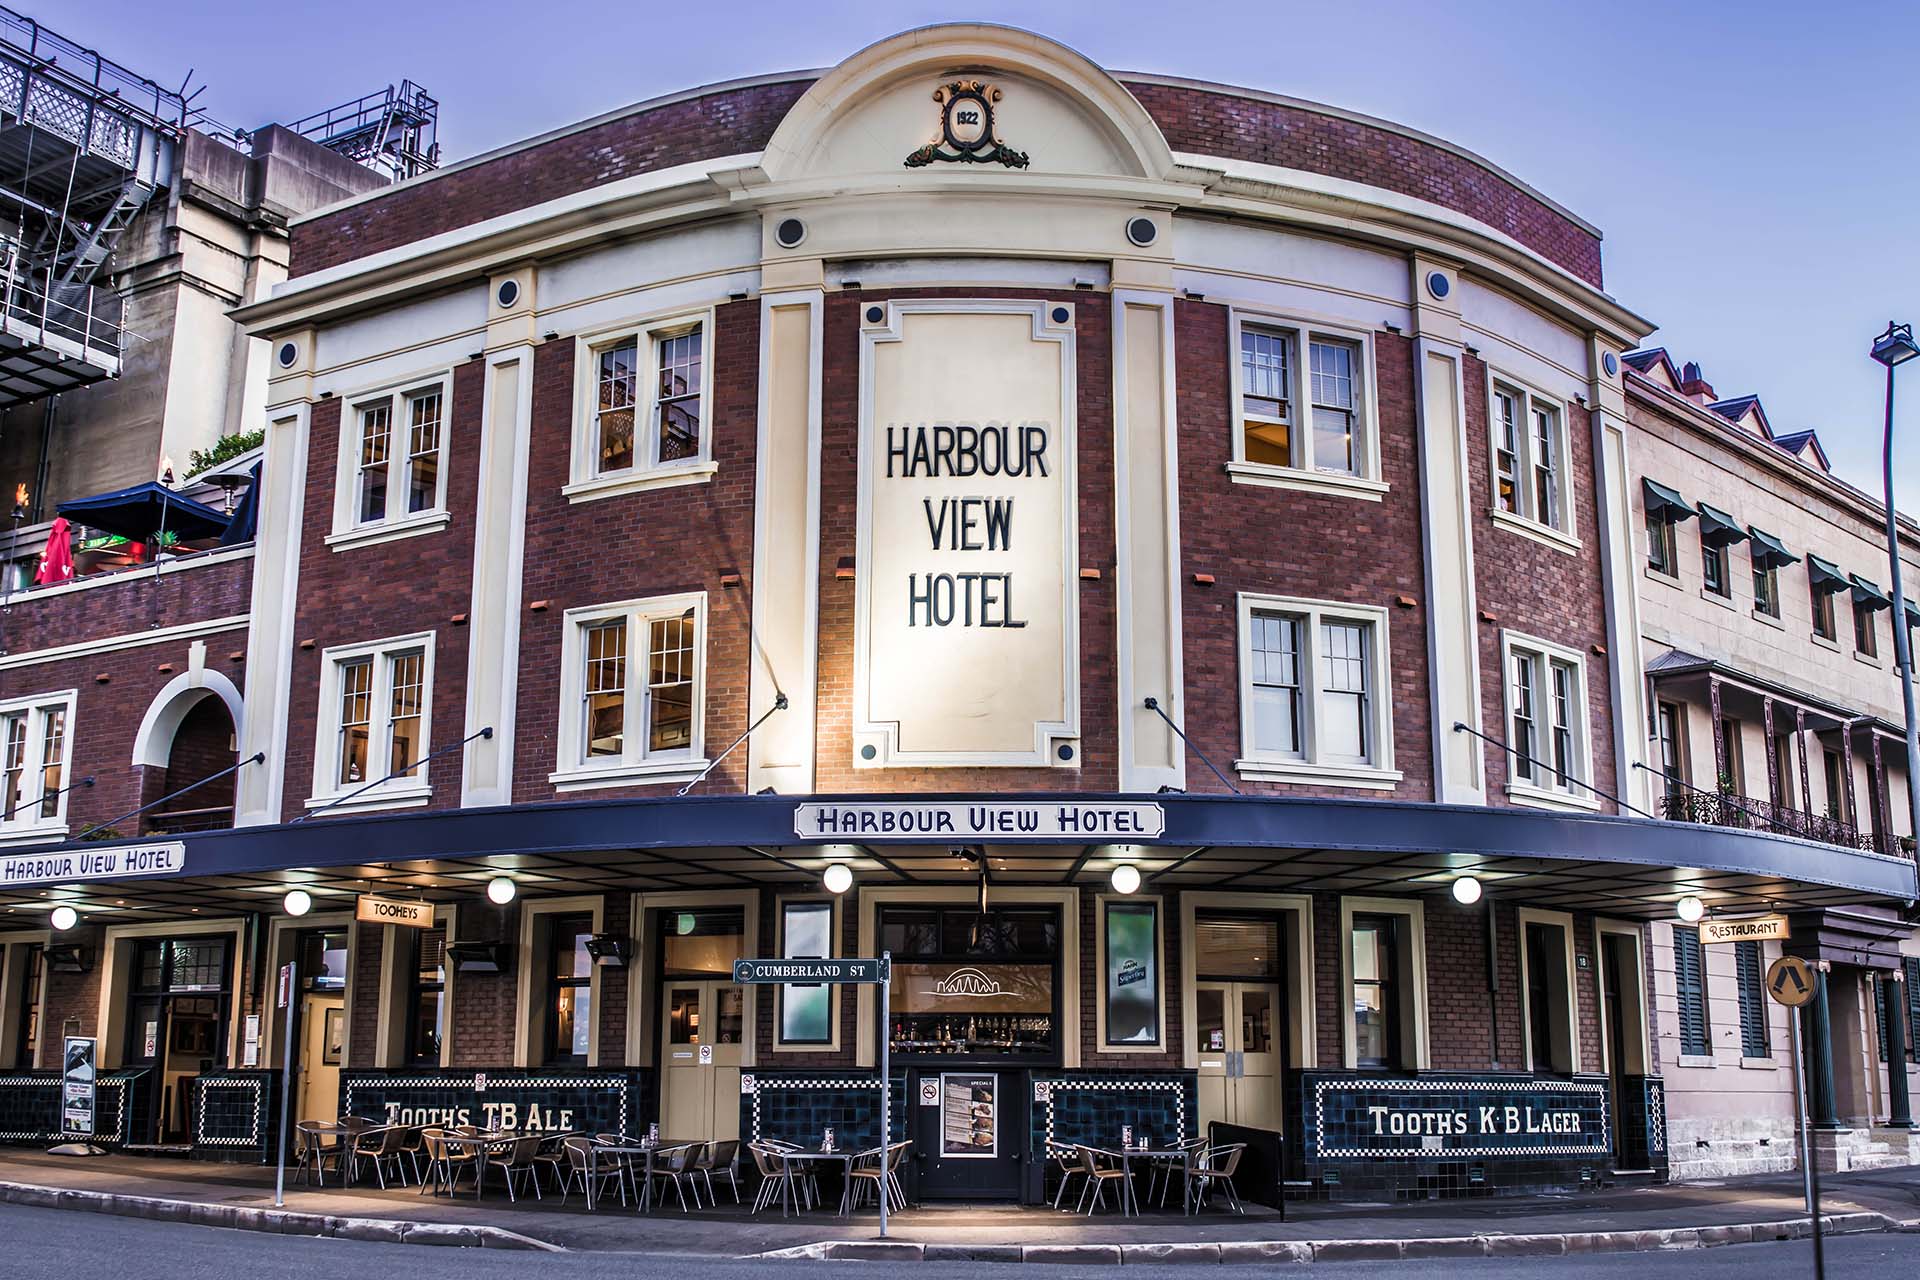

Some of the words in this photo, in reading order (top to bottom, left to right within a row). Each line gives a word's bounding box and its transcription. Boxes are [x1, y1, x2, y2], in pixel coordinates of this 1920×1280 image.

[957, 111, 979, 125] 1922
[886, 426, 1049, 478] HARBOUR
[923, 499, 1013, 551] VIEW
[908, 574, 1027, 628] HOTEL
[817, 808, 955, 833] HARBOUR
[968, 808, 1039, 833] VIEW
[1057, 807, 1145, 833] HOTEL
[5, 859, 73, 880] HARBOUR
[80, 853, 117, 875] VIEW
[126, 850, 173, 872] HOTEL
[374, 903, 418, 919] TOOHEYS
[1708, 922, 1779, 939] RESTAURANT
[755, 965, 841, 978] CUMBERLAND
[849, 965, 866, 977] ST
[1368, 1106, 1468, 1135] TOOTH'S
[1525, 1106, 1581, 1133] LAGER
